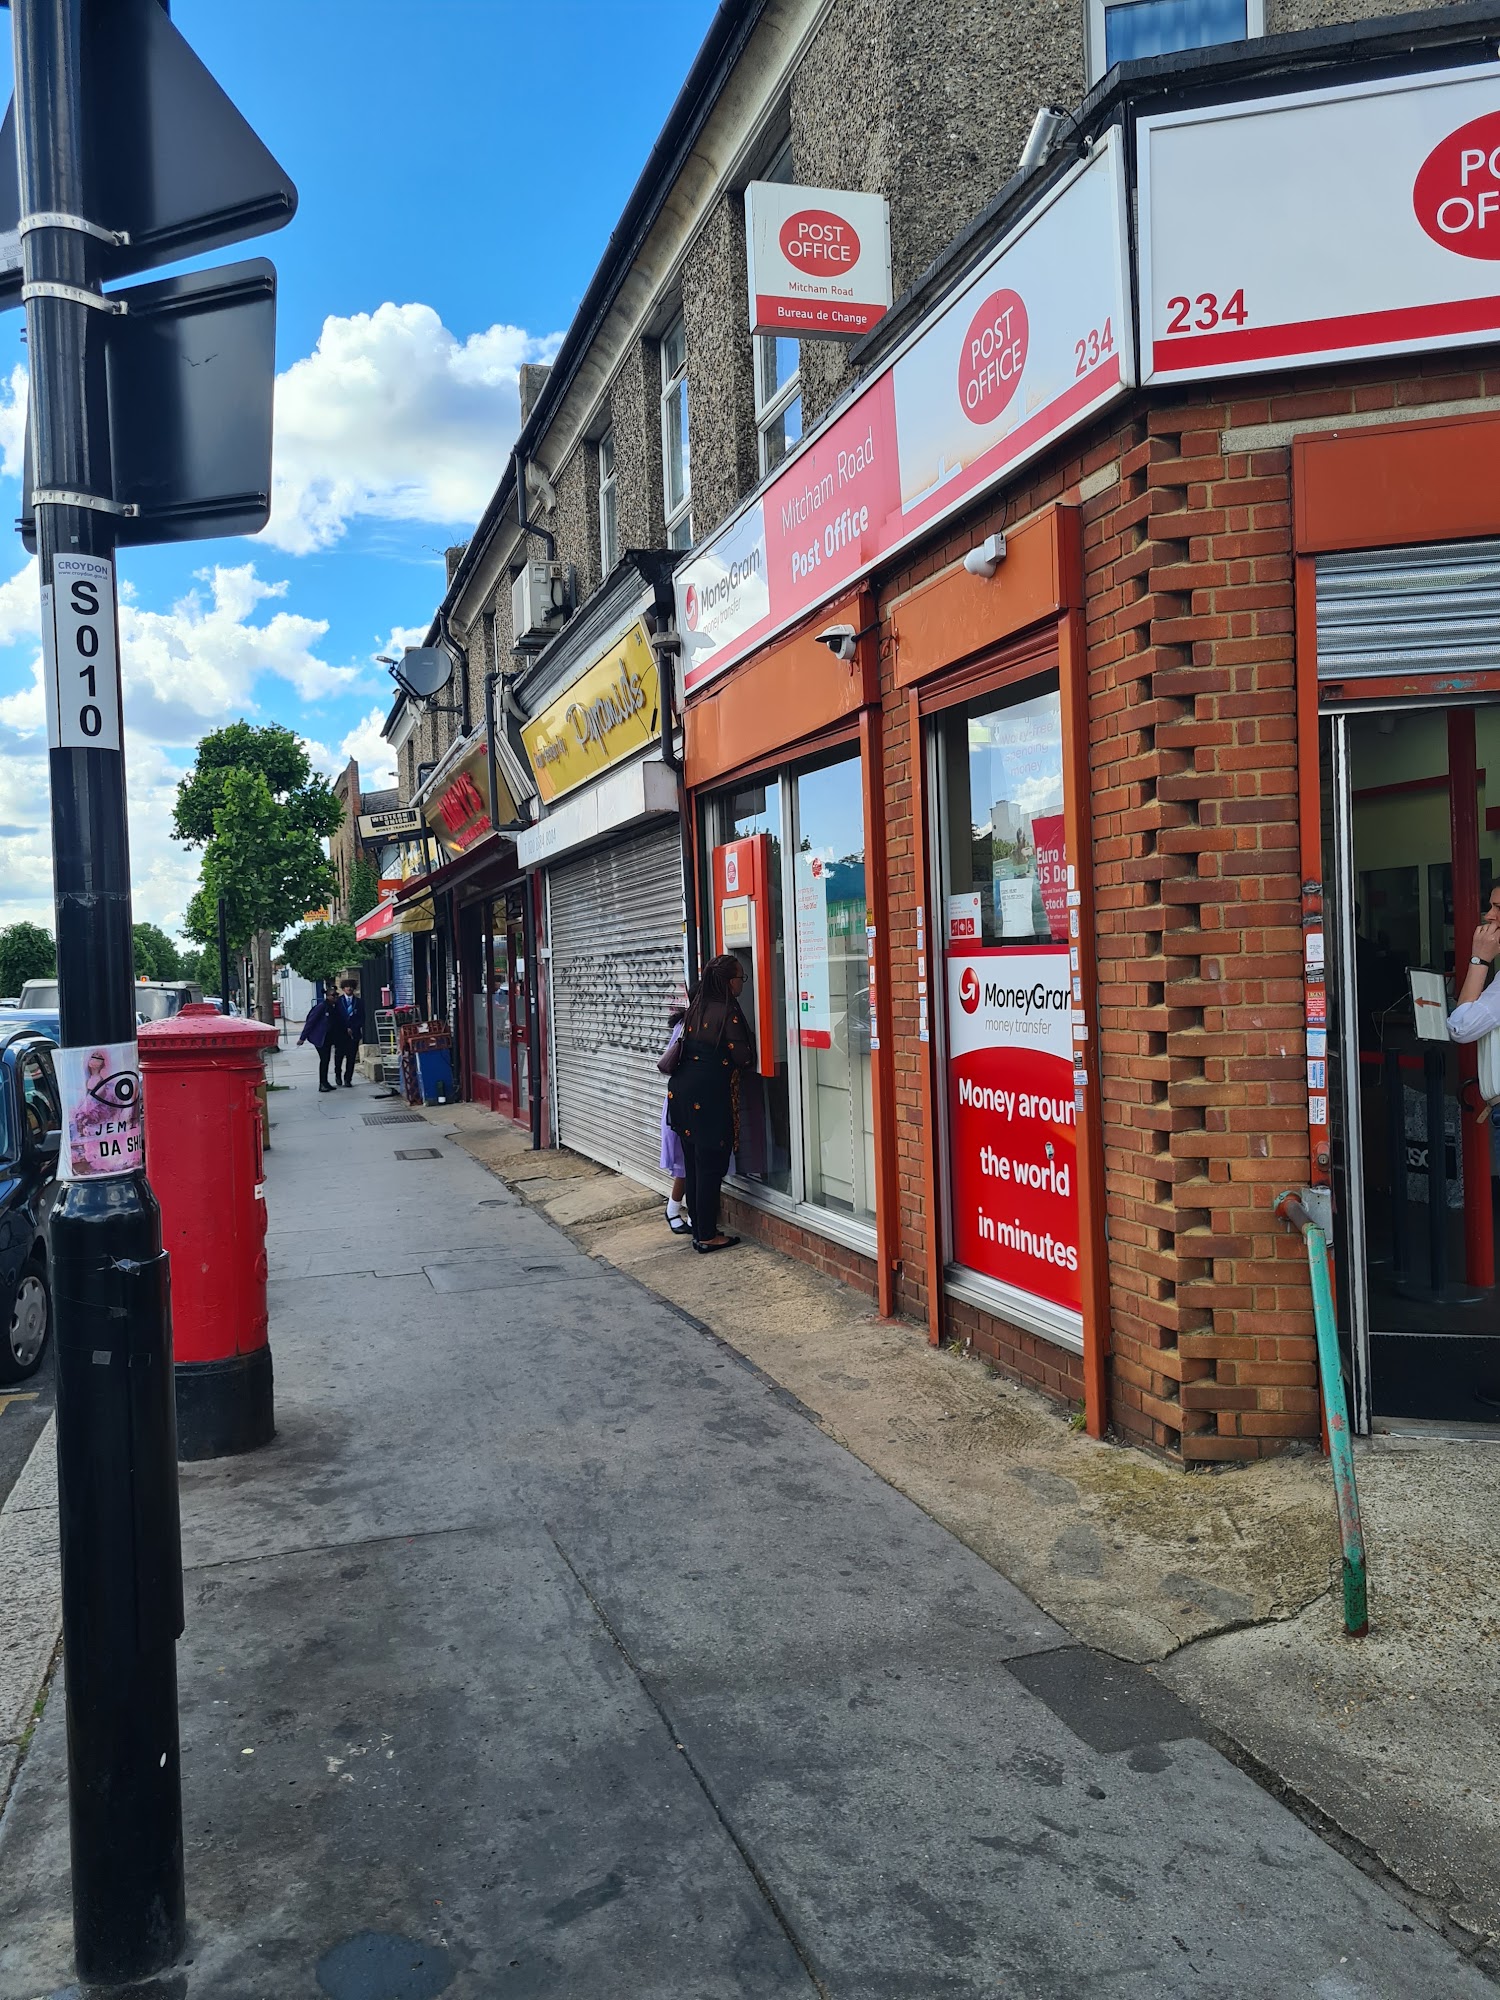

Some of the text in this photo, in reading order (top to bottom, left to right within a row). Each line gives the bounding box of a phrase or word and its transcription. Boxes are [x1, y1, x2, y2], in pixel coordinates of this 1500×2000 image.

[1436, 190, 1500, 234] OF
[798, 222, 844, 242] POST
[787, 241, 851, 262] OFFICE
[788, 281, 854, 297] Mitcham Road
[777, 306, 867, 325] Bureau de Change
[1166, 288, 1249, 335] 234
[971, 305, 1014, 371] POST
[1074, 316, 1114, 378] 234
[966, 338, 1023, 409] OFFICE
[781, 425, 875, 537] Mitcham Road
[791, 505, 869, 584] Post Office
[58, 561, 108, 575] CROYDON
[701, 548, 760, 615] MoneyGram
[720, 597, 741, 624] transfer
[70, 580, 102, 737] S010
[371, 812, 408, 823] WESTERN
[384, 817, 409, 826] UNION
[1036, 847, 1059, 865] Euro
[1037, 866, 1051, 885] US
[1045, 897, 1064, 910] stock
[985, 1018, 1052, 1036] money transfer
[958, 1077, 1015, 1122] Money
[1018, 1092, 1076, 1126] aroun
[100, 1139, 122, 1157] DA
[980, 1145, 1070, 1197] the world
[977, 1206, 1078, 1272] in minutes
